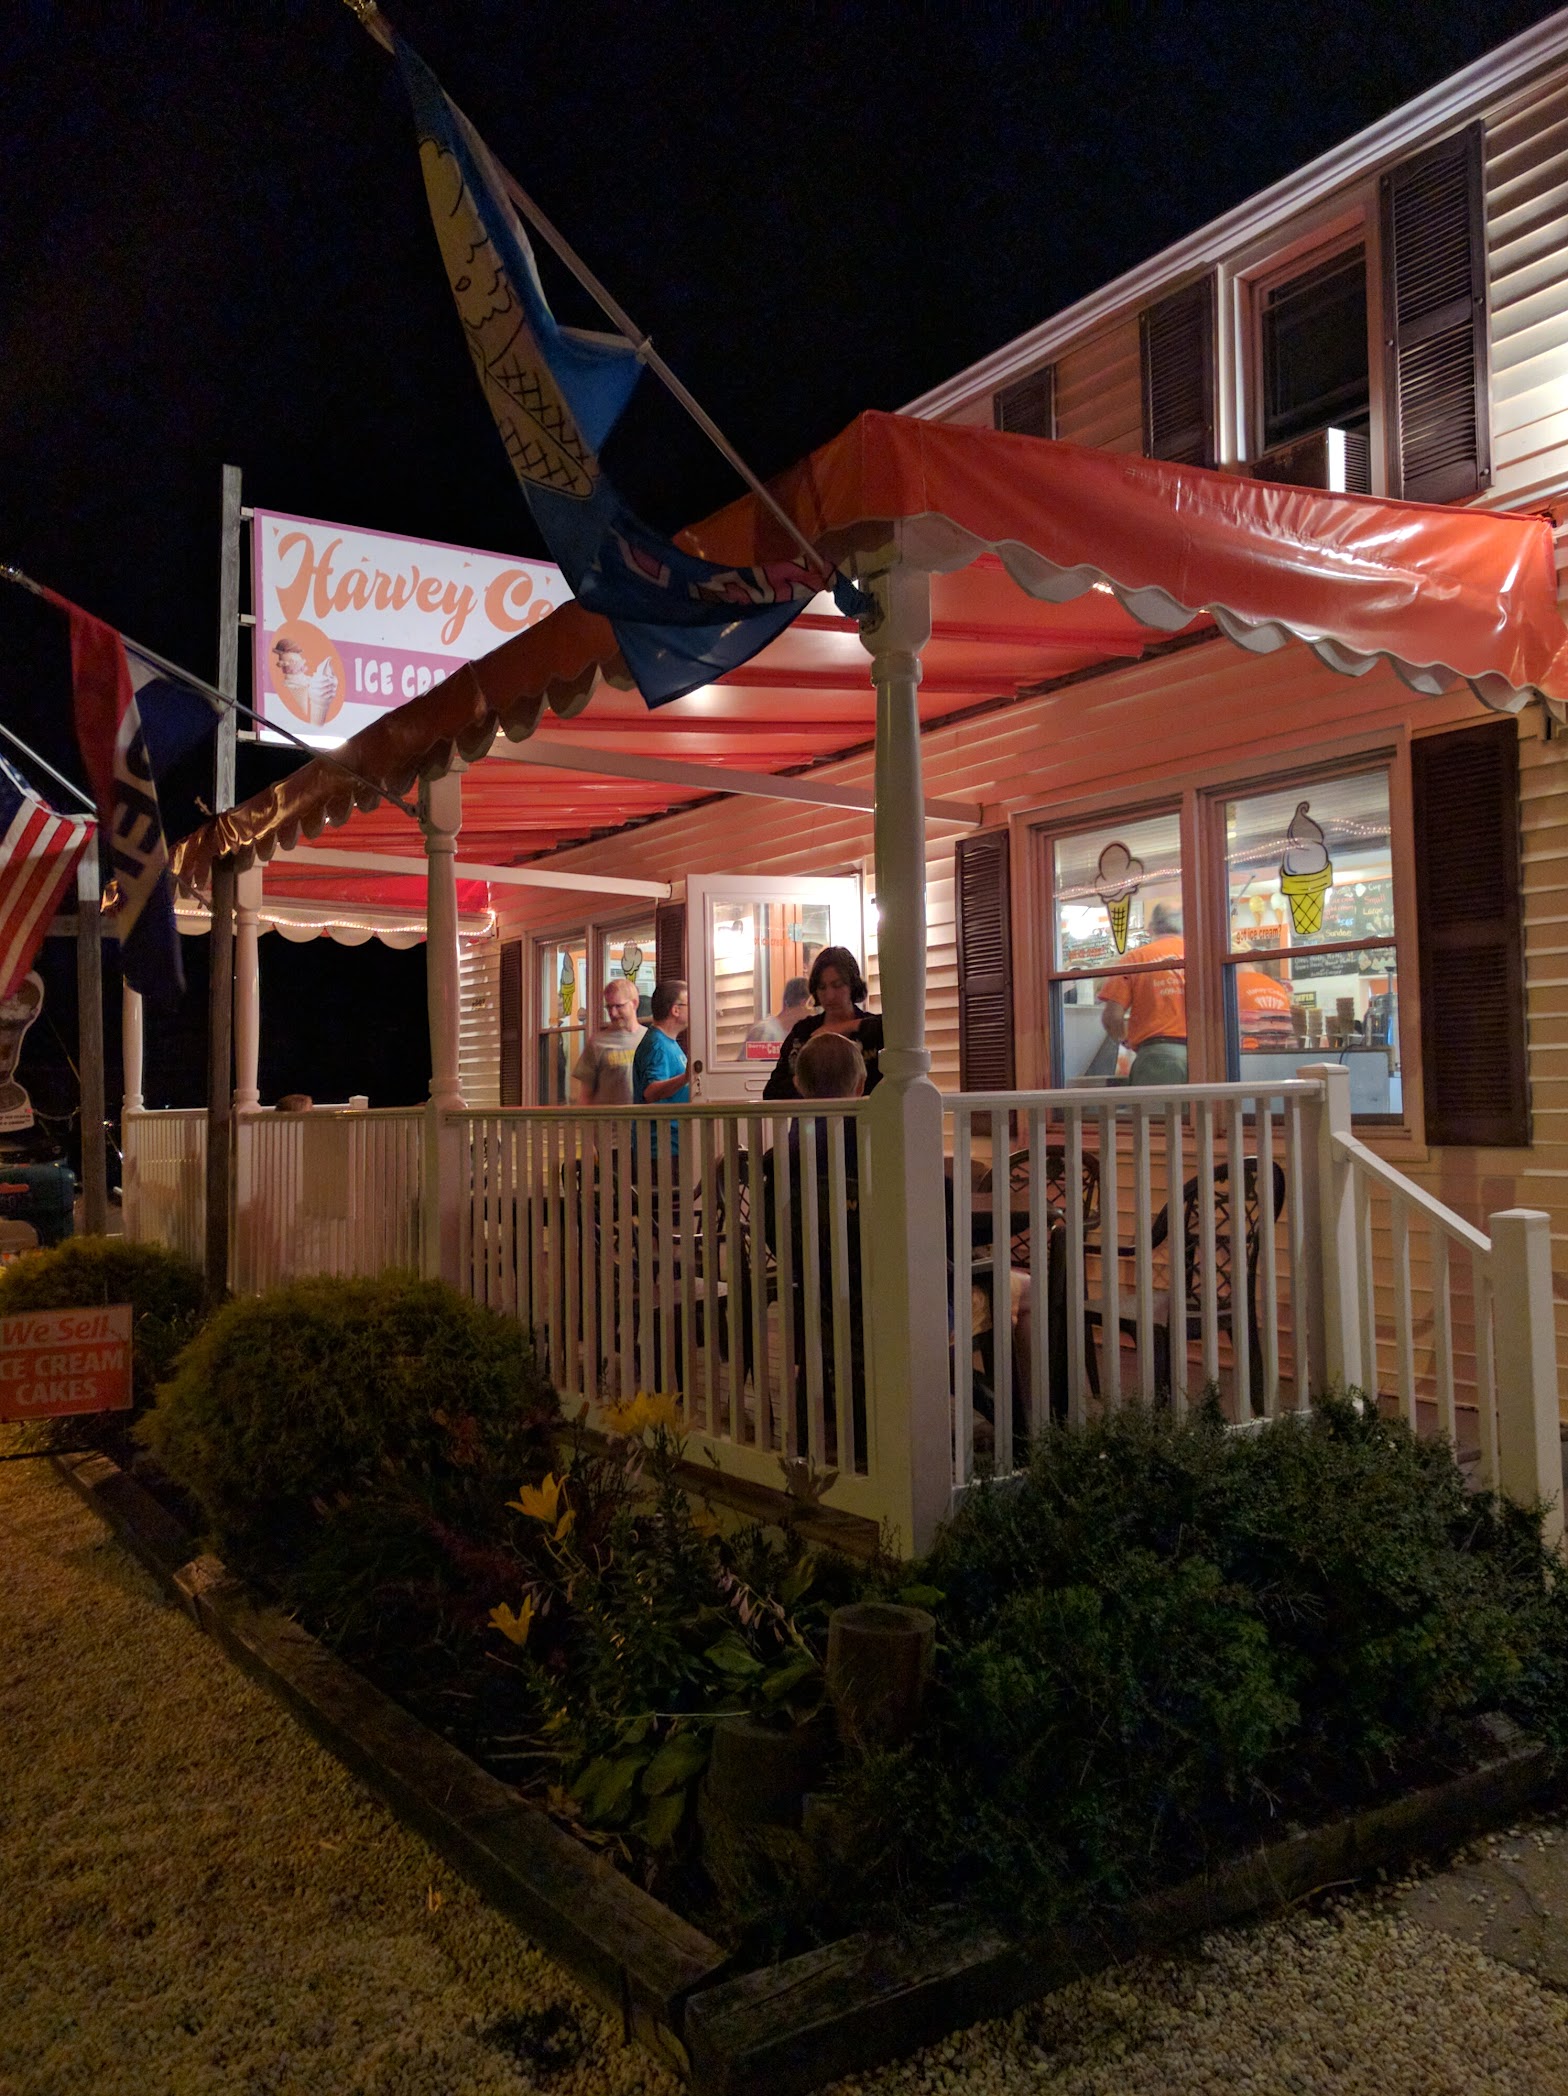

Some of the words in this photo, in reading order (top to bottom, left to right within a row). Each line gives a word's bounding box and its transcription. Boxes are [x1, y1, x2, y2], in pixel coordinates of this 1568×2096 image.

[275, 531, 478, 645] Harvey
[355, 658, 394, 695] ICE
[2, 1320, 49, 1345] We
[57, 1315, 109, 1342] Sell
[0, 1357, 27, 1381] CE
[35, 1347, 124, 1377] CREAM
[16, 1377, 98, 1406] CAKES
